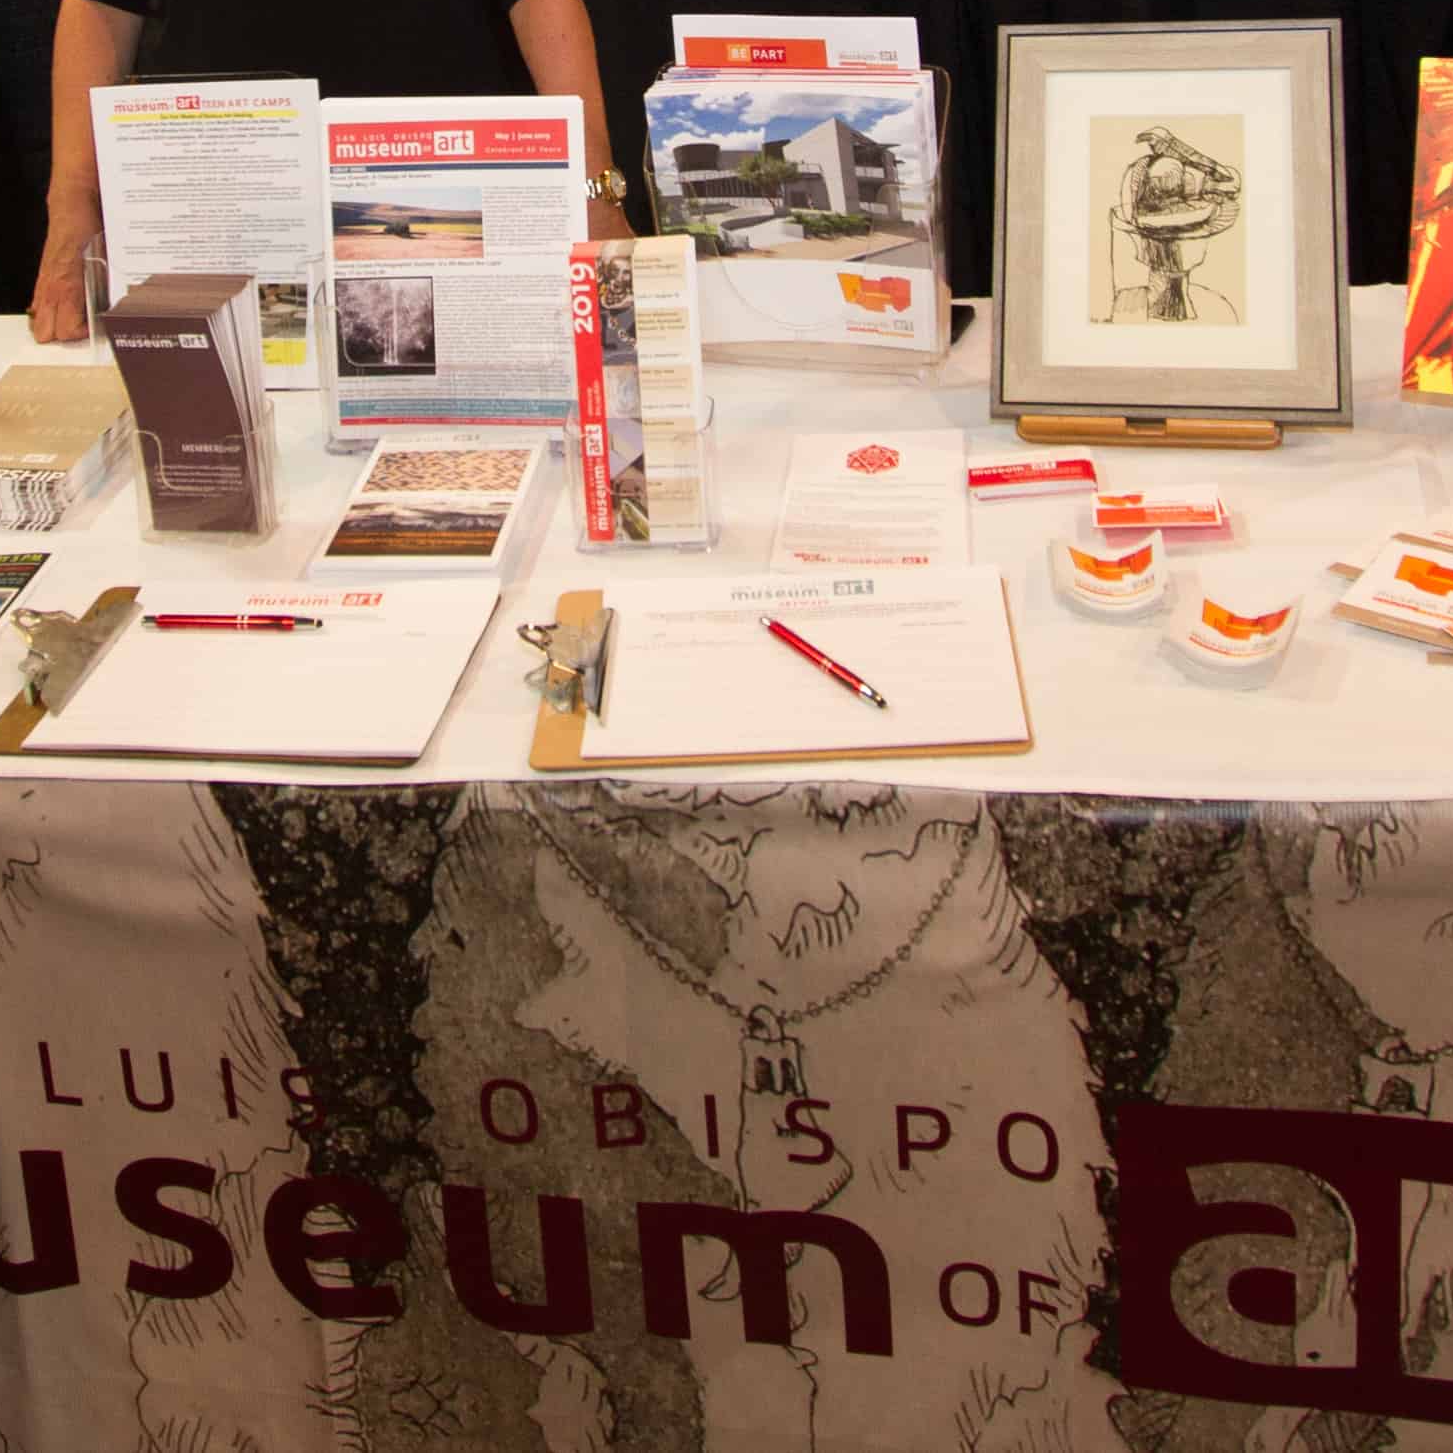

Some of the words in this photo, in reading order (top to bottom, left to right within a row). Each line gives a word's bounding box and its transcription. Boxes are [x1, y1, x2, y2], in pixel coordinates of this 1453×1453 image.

[752, 48, 785, 62] PART
[336, 140, 422, 159] museum
[435, 130, 474, 154] art
[570, 261, 595, 334] 2019
[115, 338, 172, 349] museum
[246, 593, 330, 607] museum
[730, 586, 820, 602] museum
[36, 1041, 328, 1128] LUIS
[478, 1077, 1061, 1183] OBISPO
[938, 1262, 1060, 1335] OF
